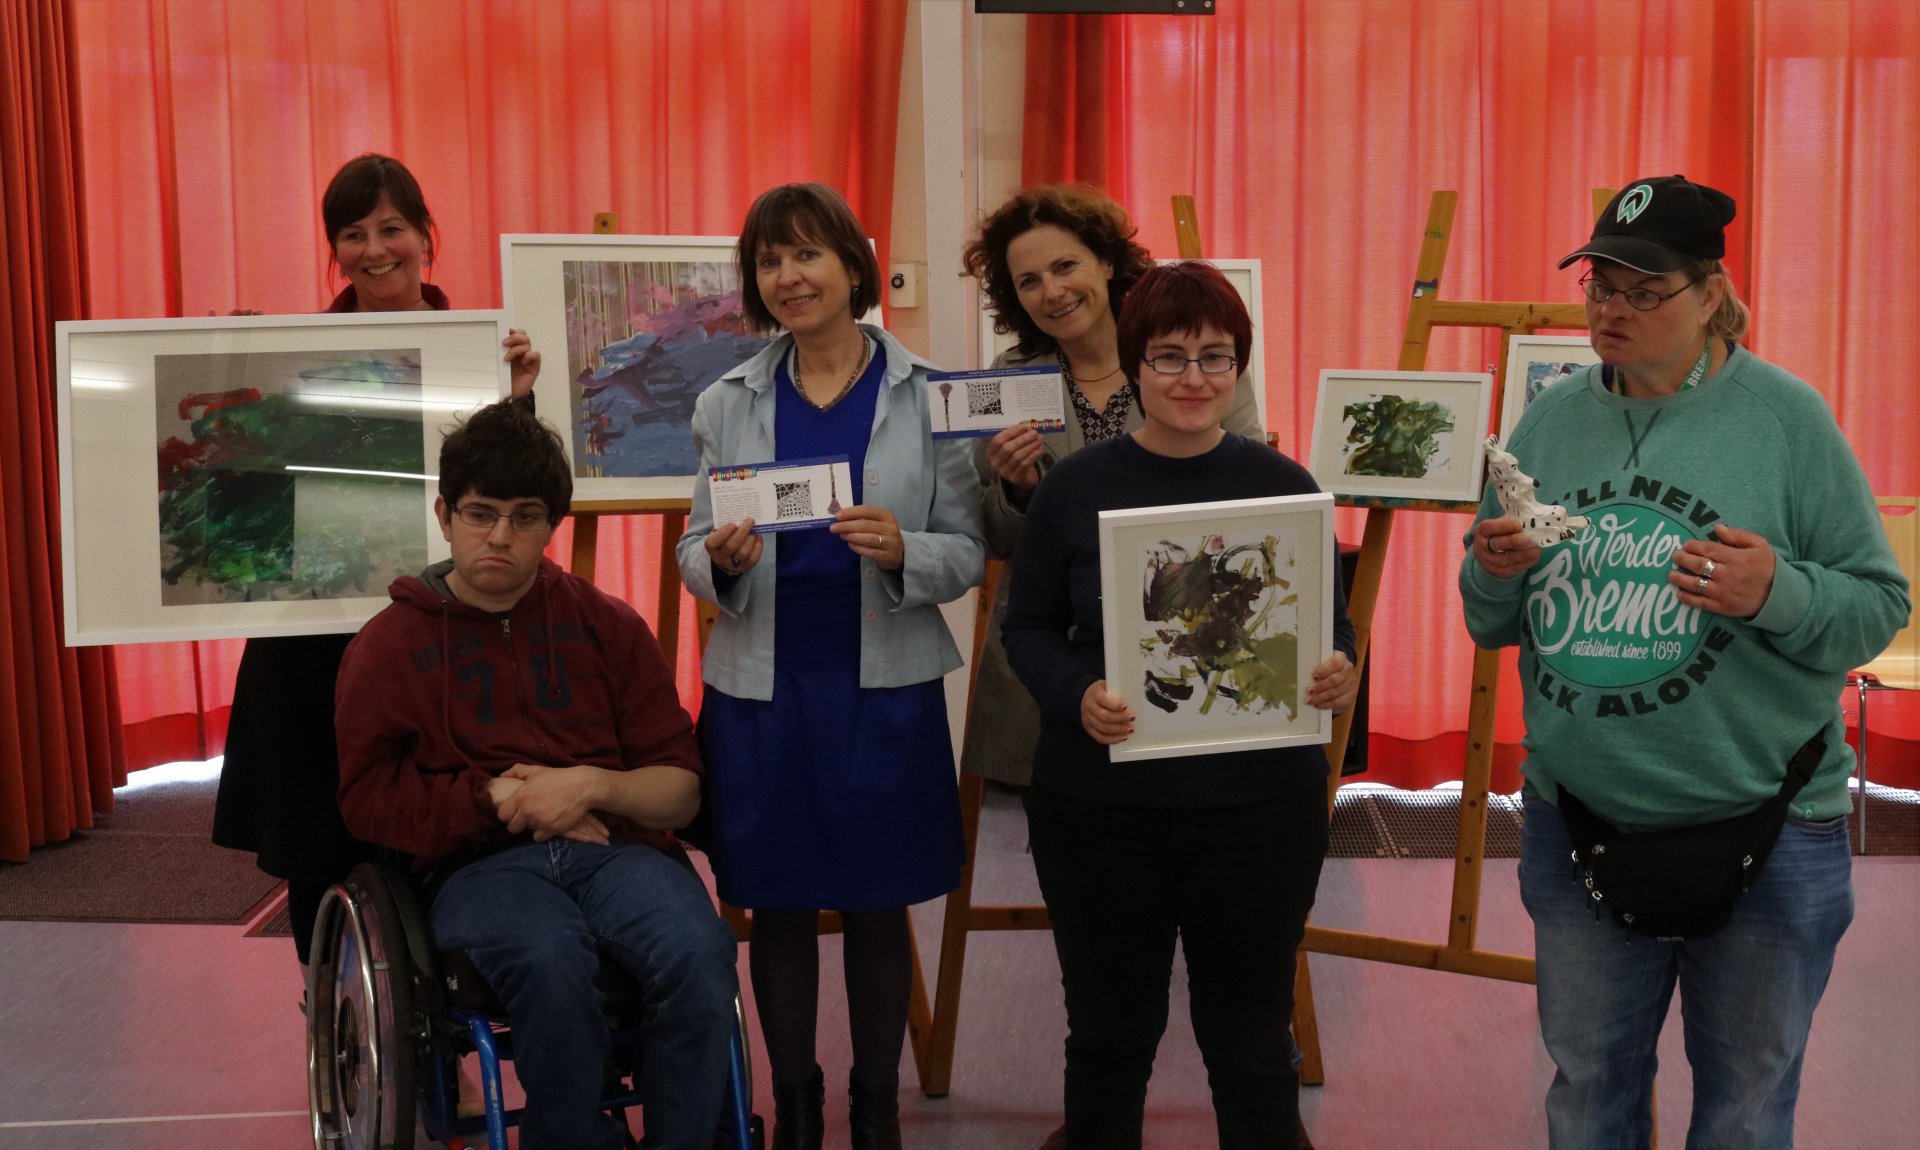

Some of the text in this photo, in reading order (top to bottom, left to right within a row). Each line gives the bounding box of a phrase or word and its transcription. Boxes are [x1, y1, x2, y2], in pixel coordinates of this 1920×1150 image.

[1570, 513, 1683, 577] Werder
[1570, 638, 1682, 660] established since 1899
[1596, 625, 1735, 717] ALONE
